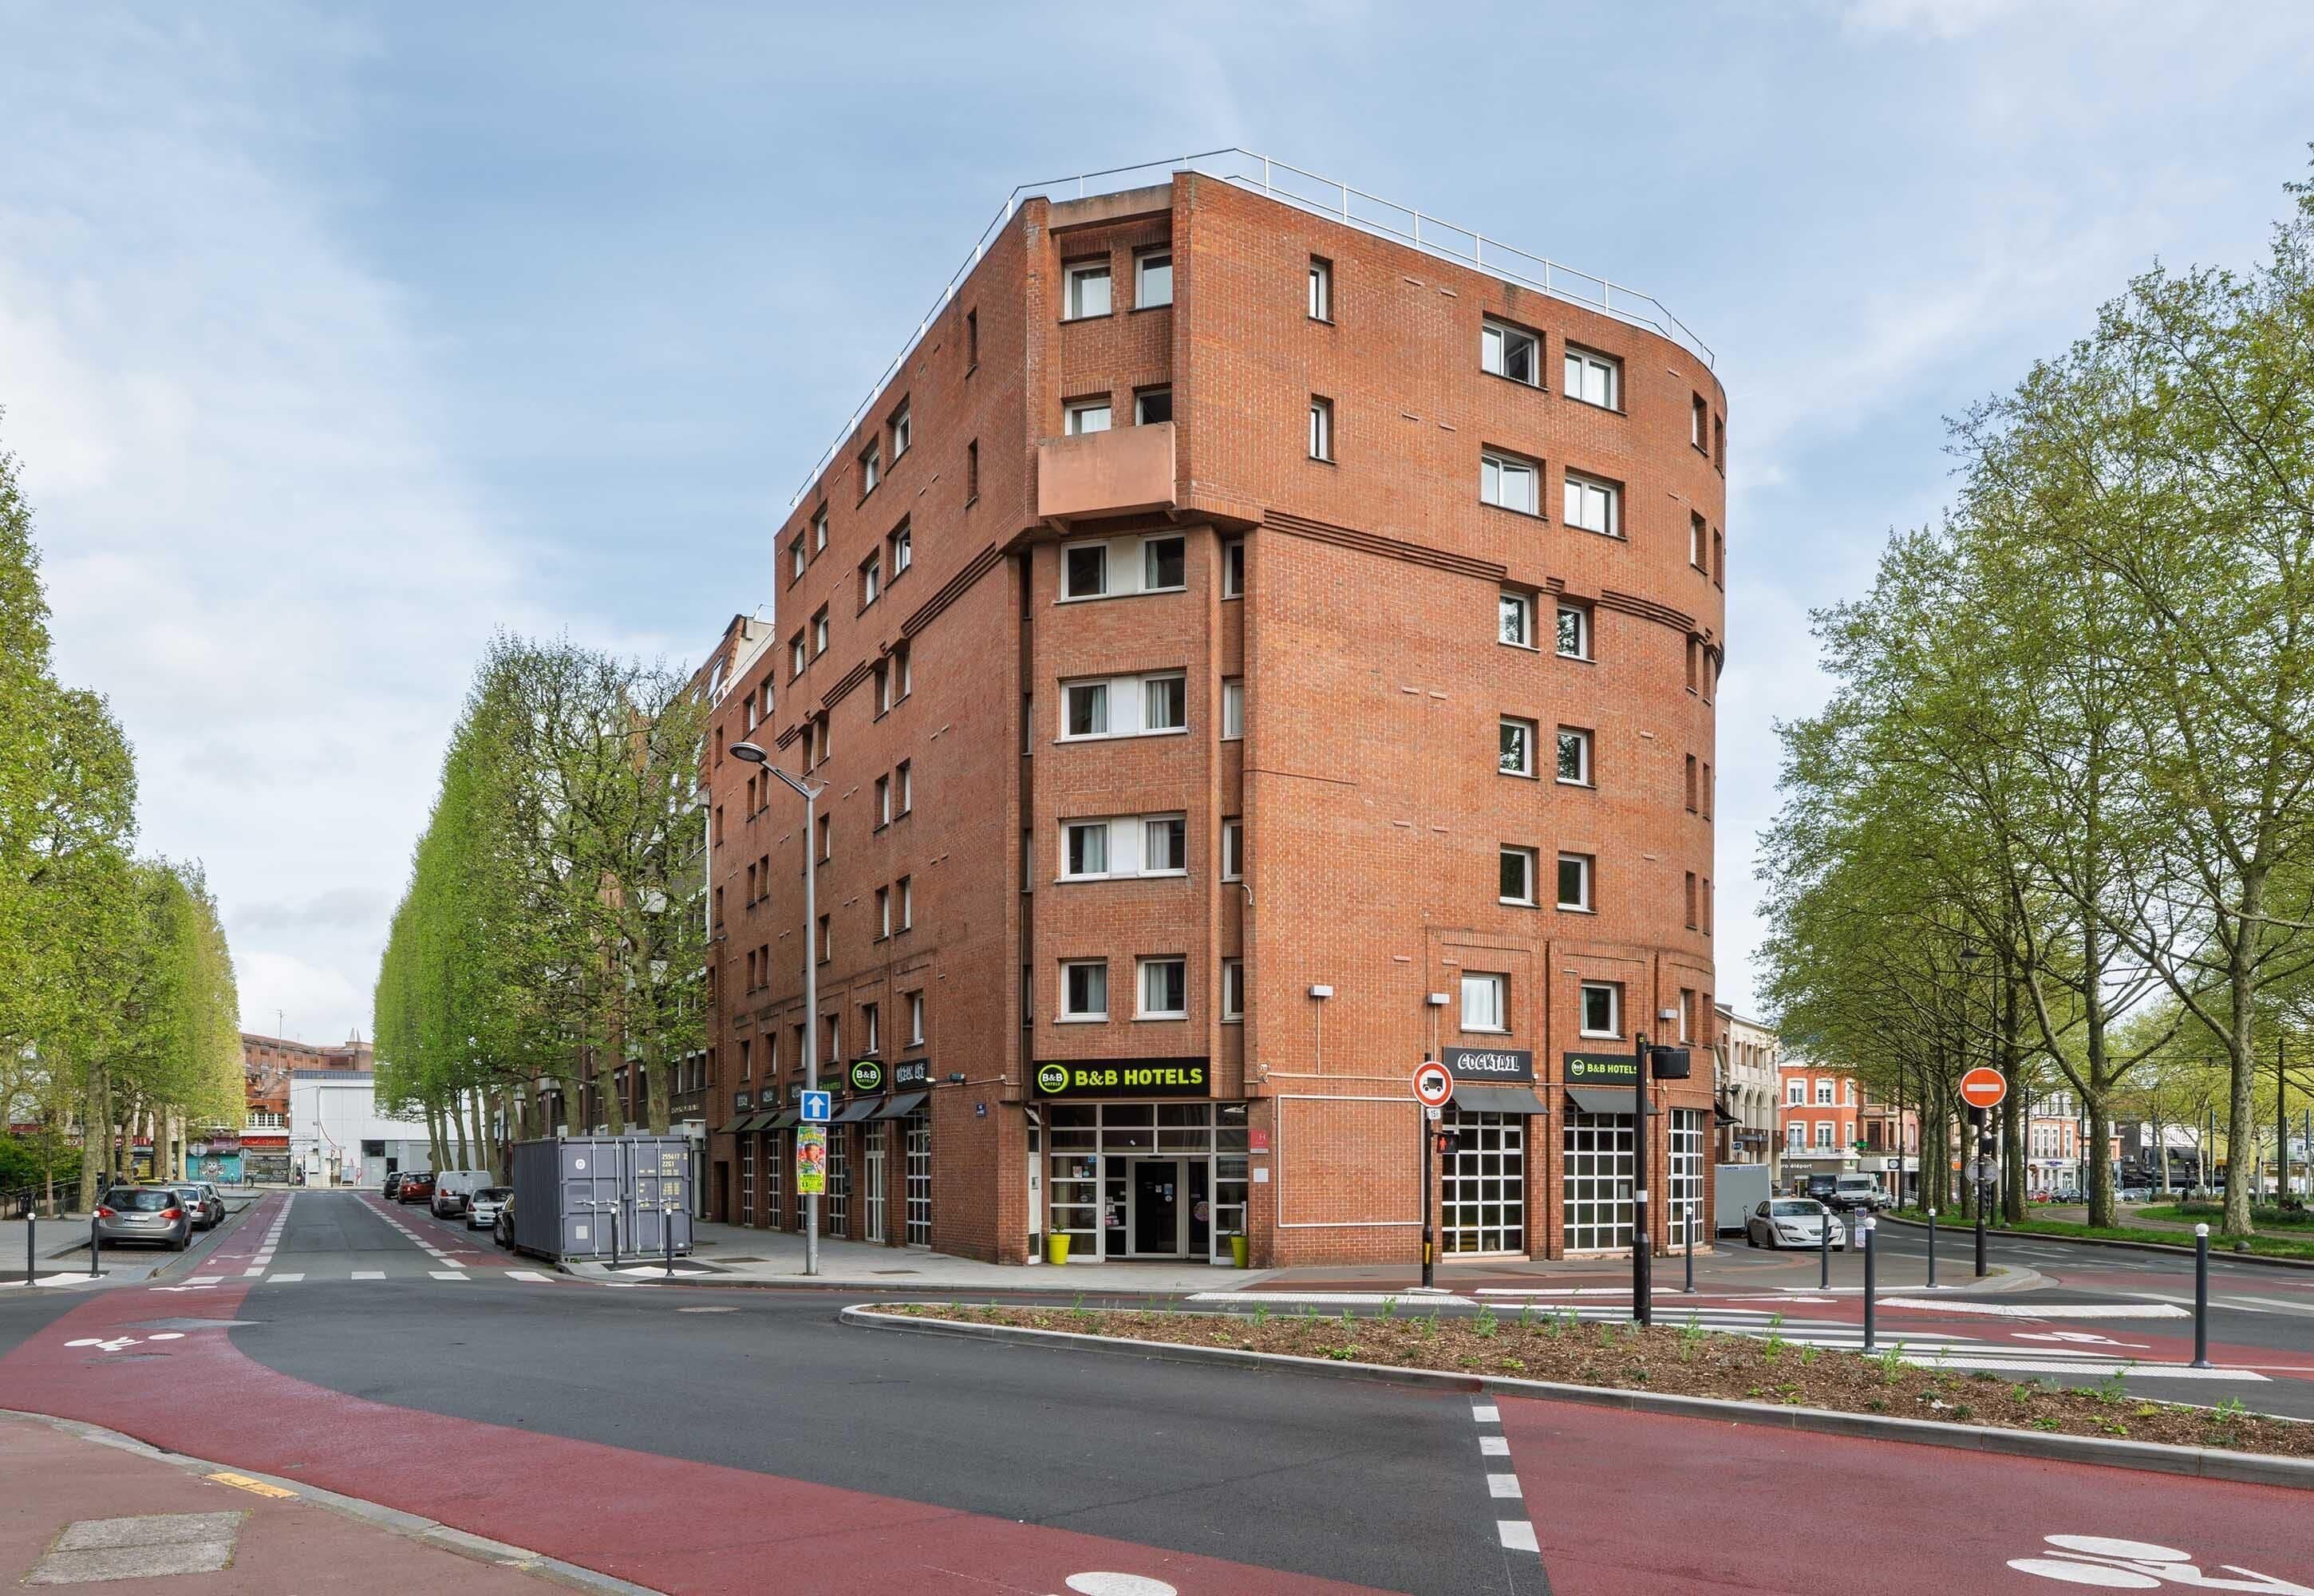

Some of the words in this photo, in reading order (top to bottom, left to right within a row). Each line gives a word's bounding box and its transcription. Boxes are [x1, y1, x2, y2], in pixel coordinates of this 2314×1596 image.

[1457, 1053, 1520, 1072] COCKTAIL
[1587, 1063, 1605, 1073] B&B
[1607, 1064, 1637, 1074] HOTELS
[856, 1070, 877, 1079] B&B
[1042, 1073, 1063, 1082] B&B
[1075, 1069, 1118, 1086] B&B
[1124, 1068, 1202, 1085] HOTELS
